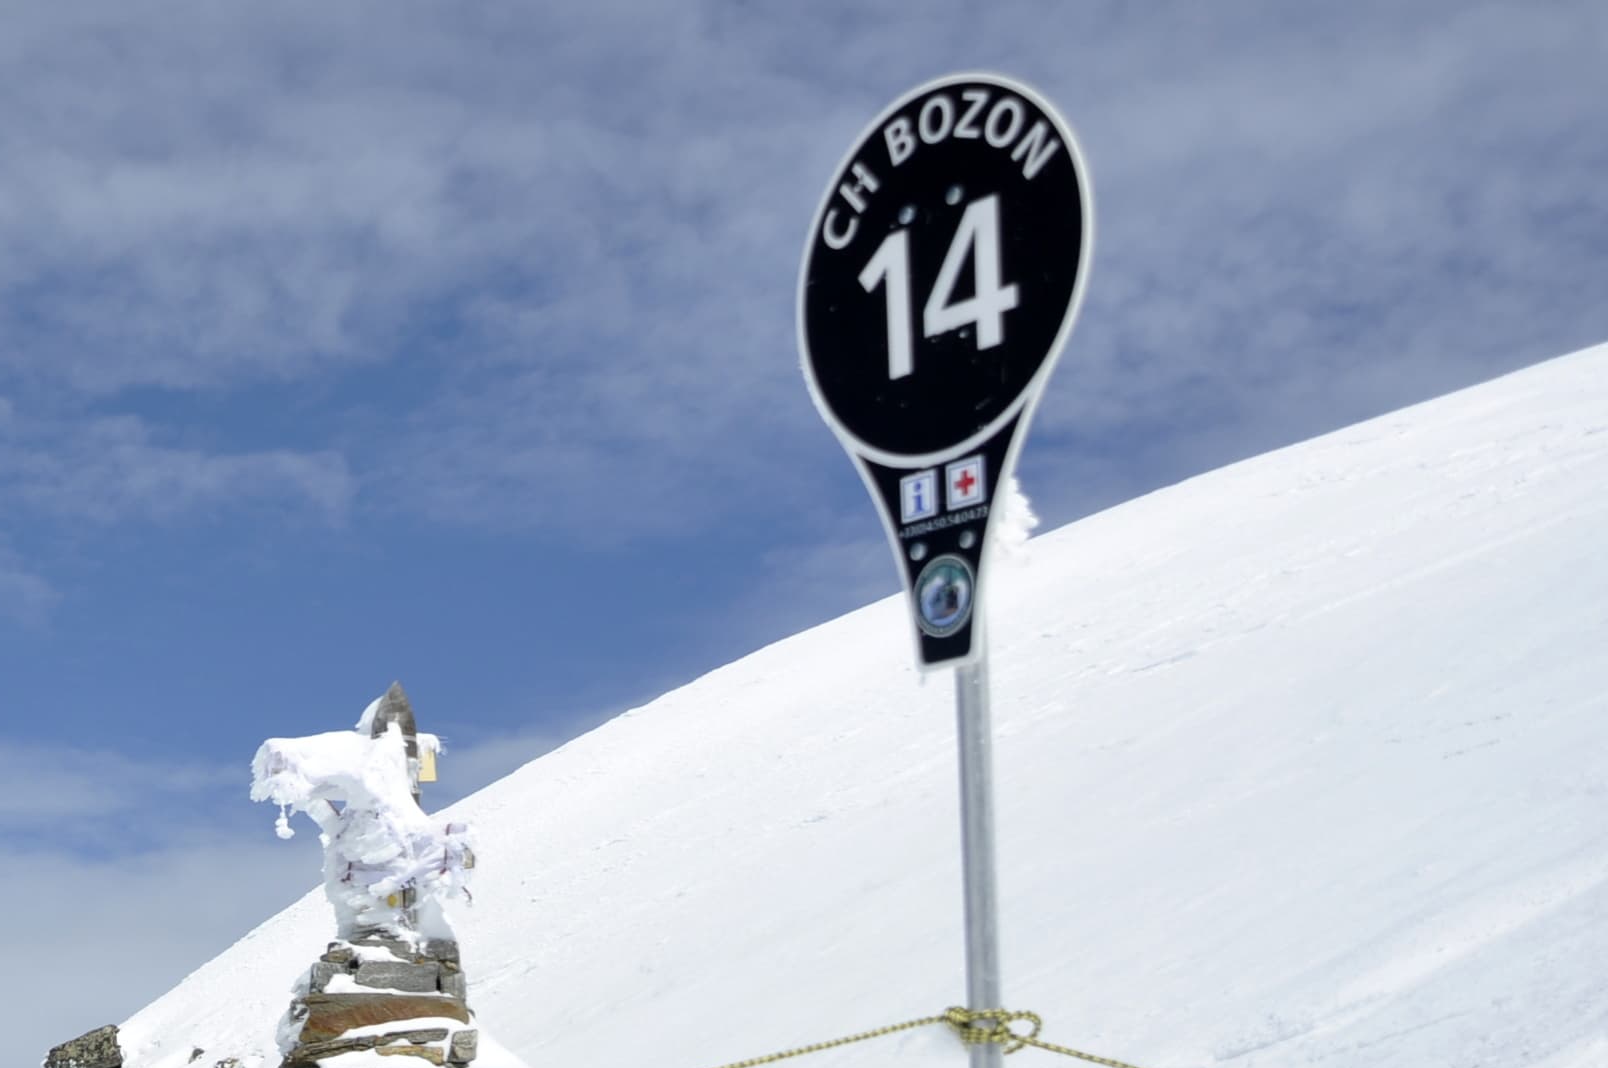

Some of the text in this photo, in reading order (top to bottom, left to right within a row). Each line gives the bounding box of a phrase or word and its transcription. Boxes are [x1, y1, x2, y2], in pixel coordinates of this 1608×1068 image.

[822, 88, 1061, 251] CH BOZON
[857, 193, 1020, 381] 14
